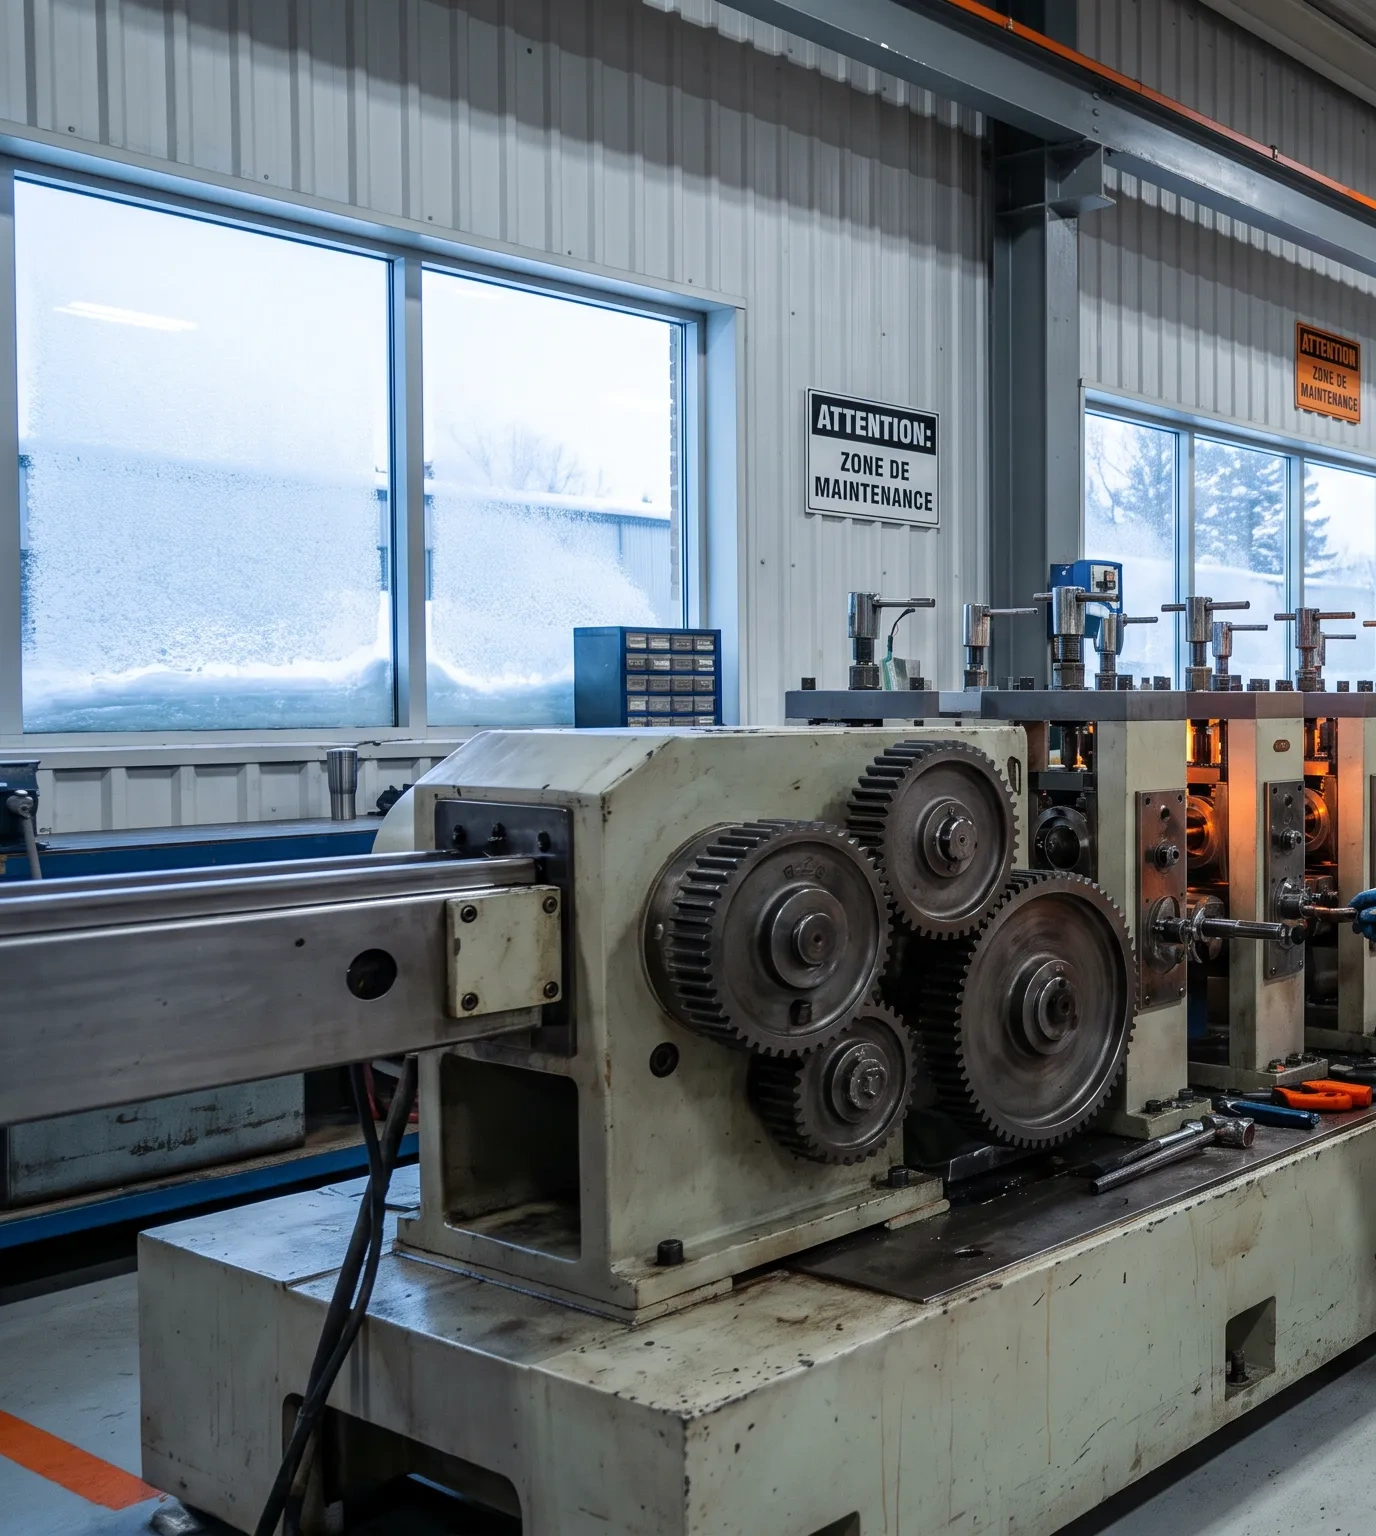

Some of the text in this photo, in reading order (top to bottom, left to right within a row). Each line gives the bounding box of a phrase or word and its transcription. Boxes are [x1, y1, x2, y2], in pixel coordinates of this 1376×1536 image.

[1301, 332, 1356, 367] ATTENTION
[1312, 365, 1347, 389] ZONE DE
[1301, 382, 1358, 412] MAINTENANCE
[816, 403, 932, 448] ATTENTION:
[840, 451, 910, 481] ZONE DE
[814, 475, 933, 512] MAINTENANCE
